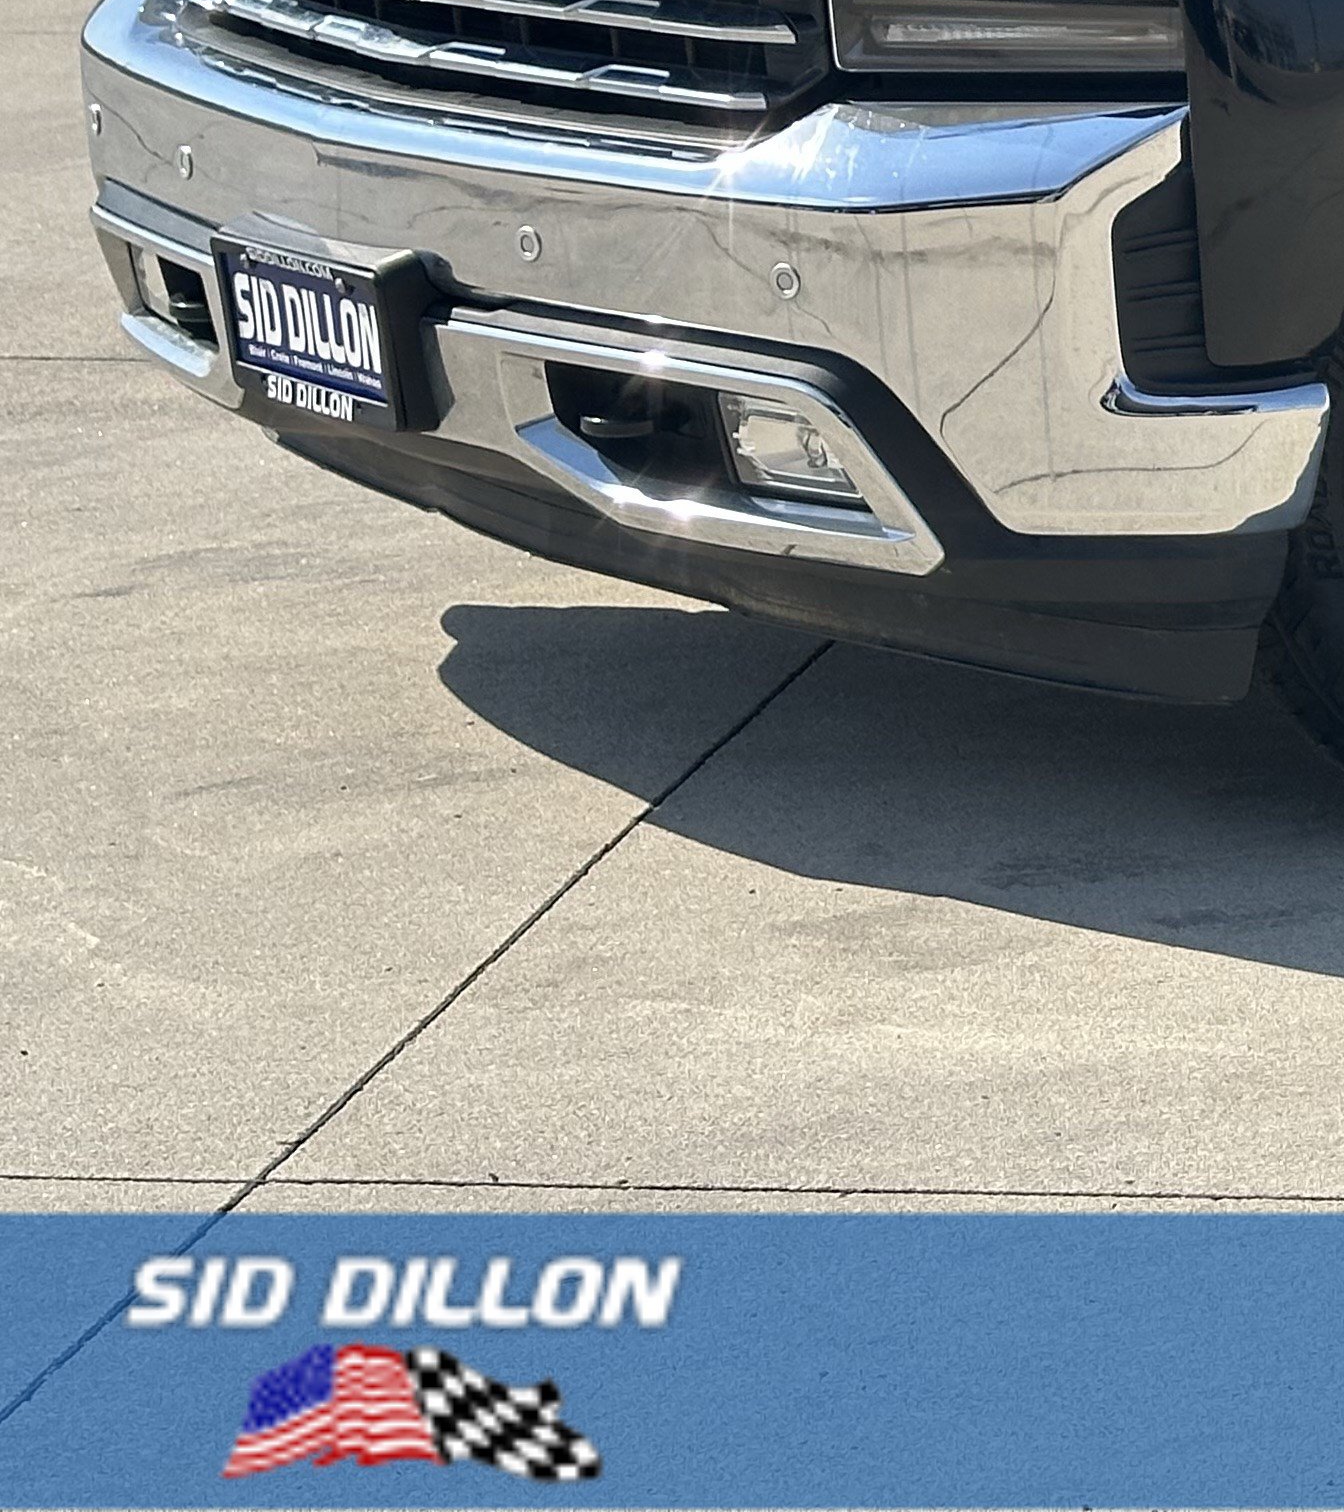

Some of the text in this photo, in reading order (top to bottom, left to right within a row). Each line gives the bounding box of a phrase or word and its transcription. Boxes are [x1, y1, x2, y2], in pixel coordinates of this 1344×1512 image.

[233, 272, 382, 375] SID DILLON
[266, 374, 354, 422] SID DILLON
